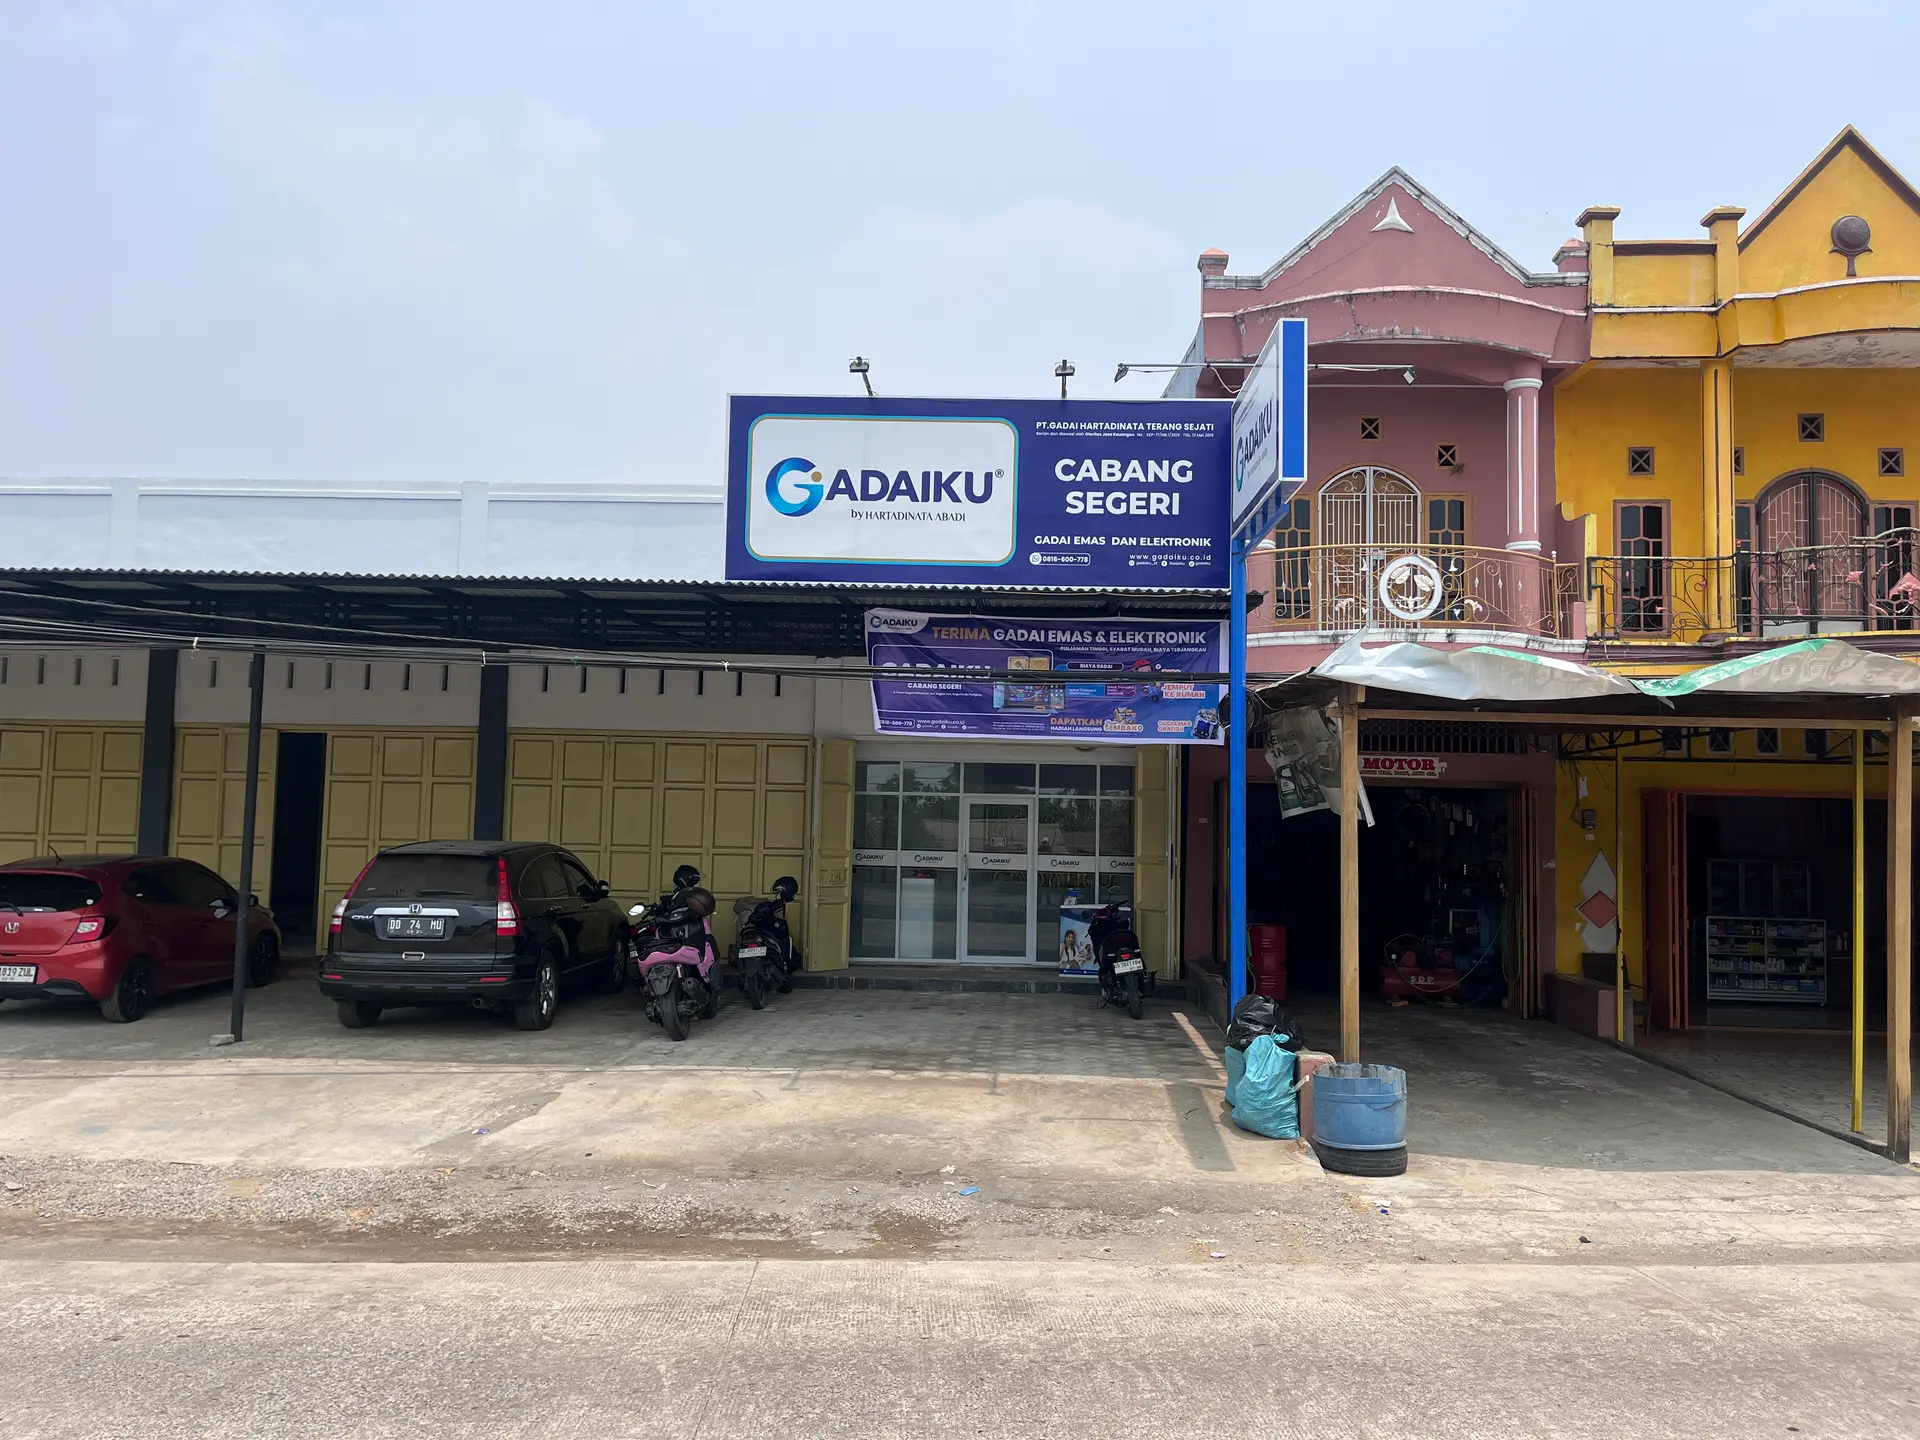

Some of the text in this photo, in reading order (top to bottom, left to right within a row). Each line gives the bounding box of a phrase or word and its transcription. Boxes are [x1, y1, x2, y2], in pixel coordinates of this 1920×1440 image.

[1036, 421, 1214, 432] PT.GADAI HARTADINATA TERANG SEJATI
[1054, 458, 1193, 483] CABANG
[1065, 491, 1180, 516] SEGERI
[851, 509, 966, 522] by HARTADINATA ABADI
[1034, 536, 1212, 547] GADAI EMAS DAN ELEKTRONIK
[1129, 554, 1212, 562] www.gadaiku.co.id
[932, 626, 1206, 645] TERIMA GADAI EMAS & ELEKTRONIK
[908, 682, 938, 690] CABANG
[1050, 718, 1102, 726] DAPATKAN
[1104, 724, 1142, 732] SEMBAKO
[1363, 758, 1436, 770] MOTOR
[390, 920, 442, 930] DD 74 MU
[18, 968, 33, 977] ZUL
